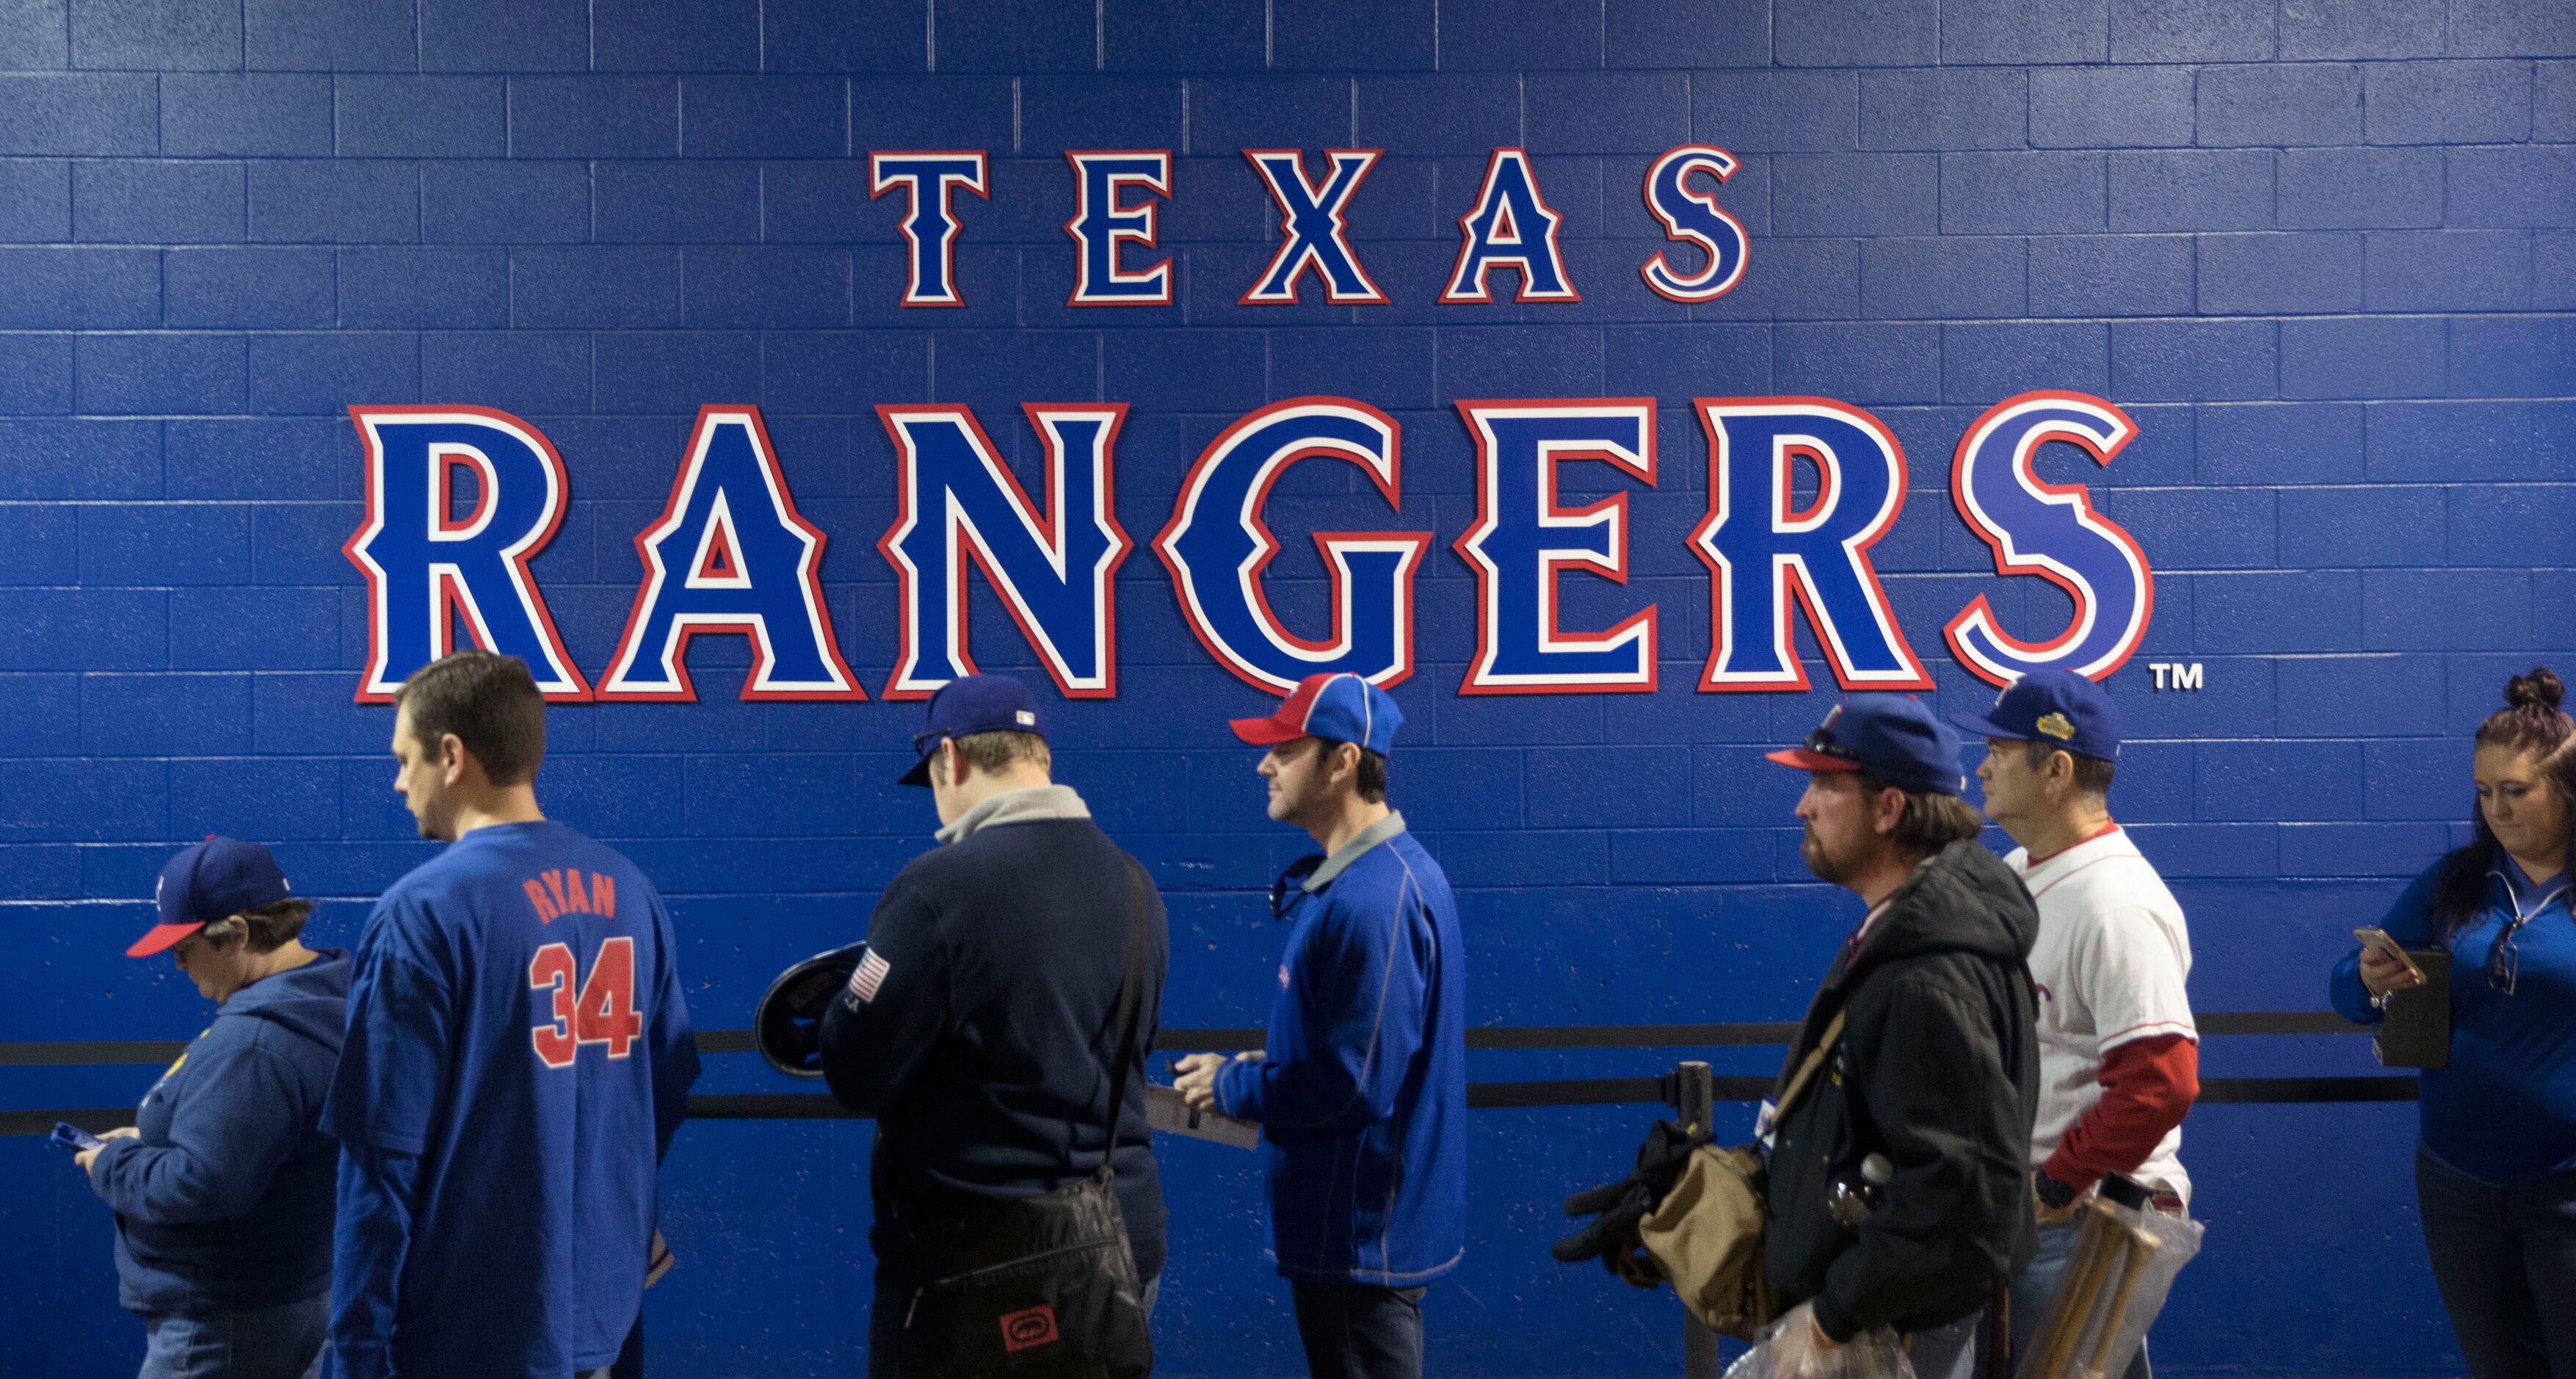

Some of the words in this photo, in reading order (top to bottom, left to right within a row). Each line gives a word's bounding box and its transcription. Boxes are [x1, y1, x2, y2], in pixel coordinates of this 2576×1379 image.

[869, 145, 1750, 306] TEXAS
[342, 390, 2154, 703] RANGERS
[2149, 663, 2203, 689] TM
[523, 869, 615, 926] RYAN
[529, 936, 642, 1068] 34
